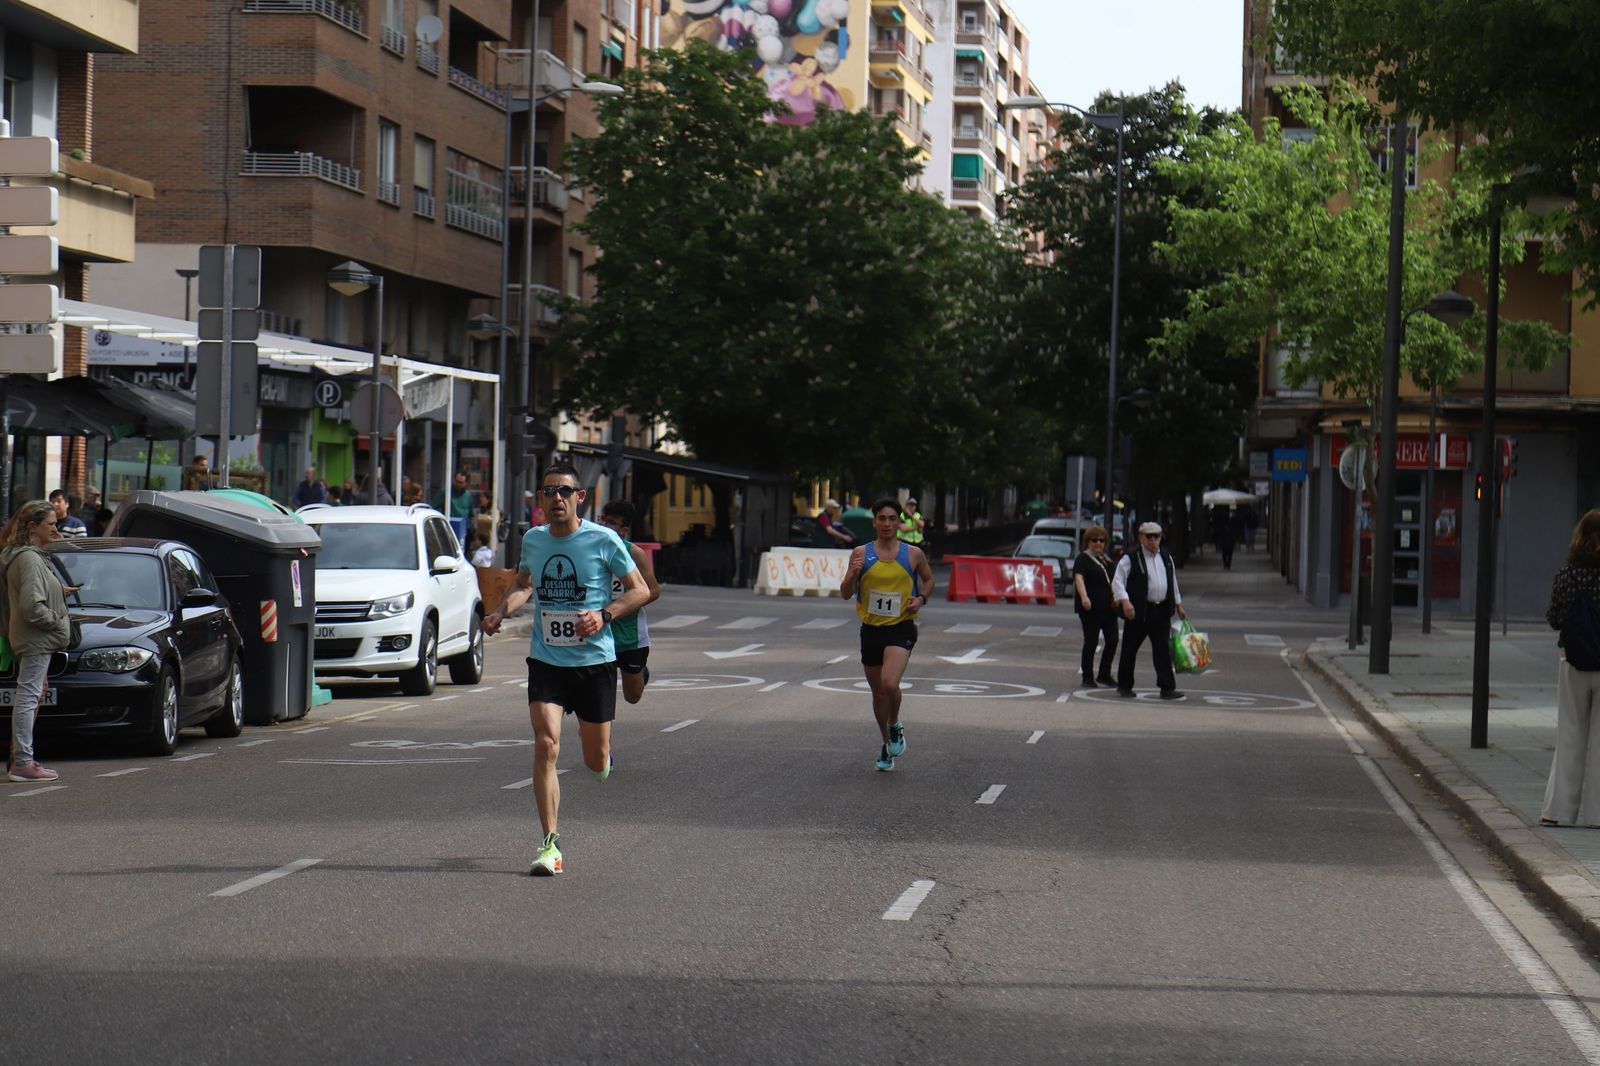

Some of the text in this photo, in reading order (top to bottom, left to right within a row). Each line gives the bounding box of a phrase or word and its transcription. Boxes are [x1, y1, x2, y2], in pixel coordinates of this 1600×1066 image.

[547, 588, 576, 598] BARRO
[876, 598, 892, 611] 11
[550, 620, 575, 638] 88
